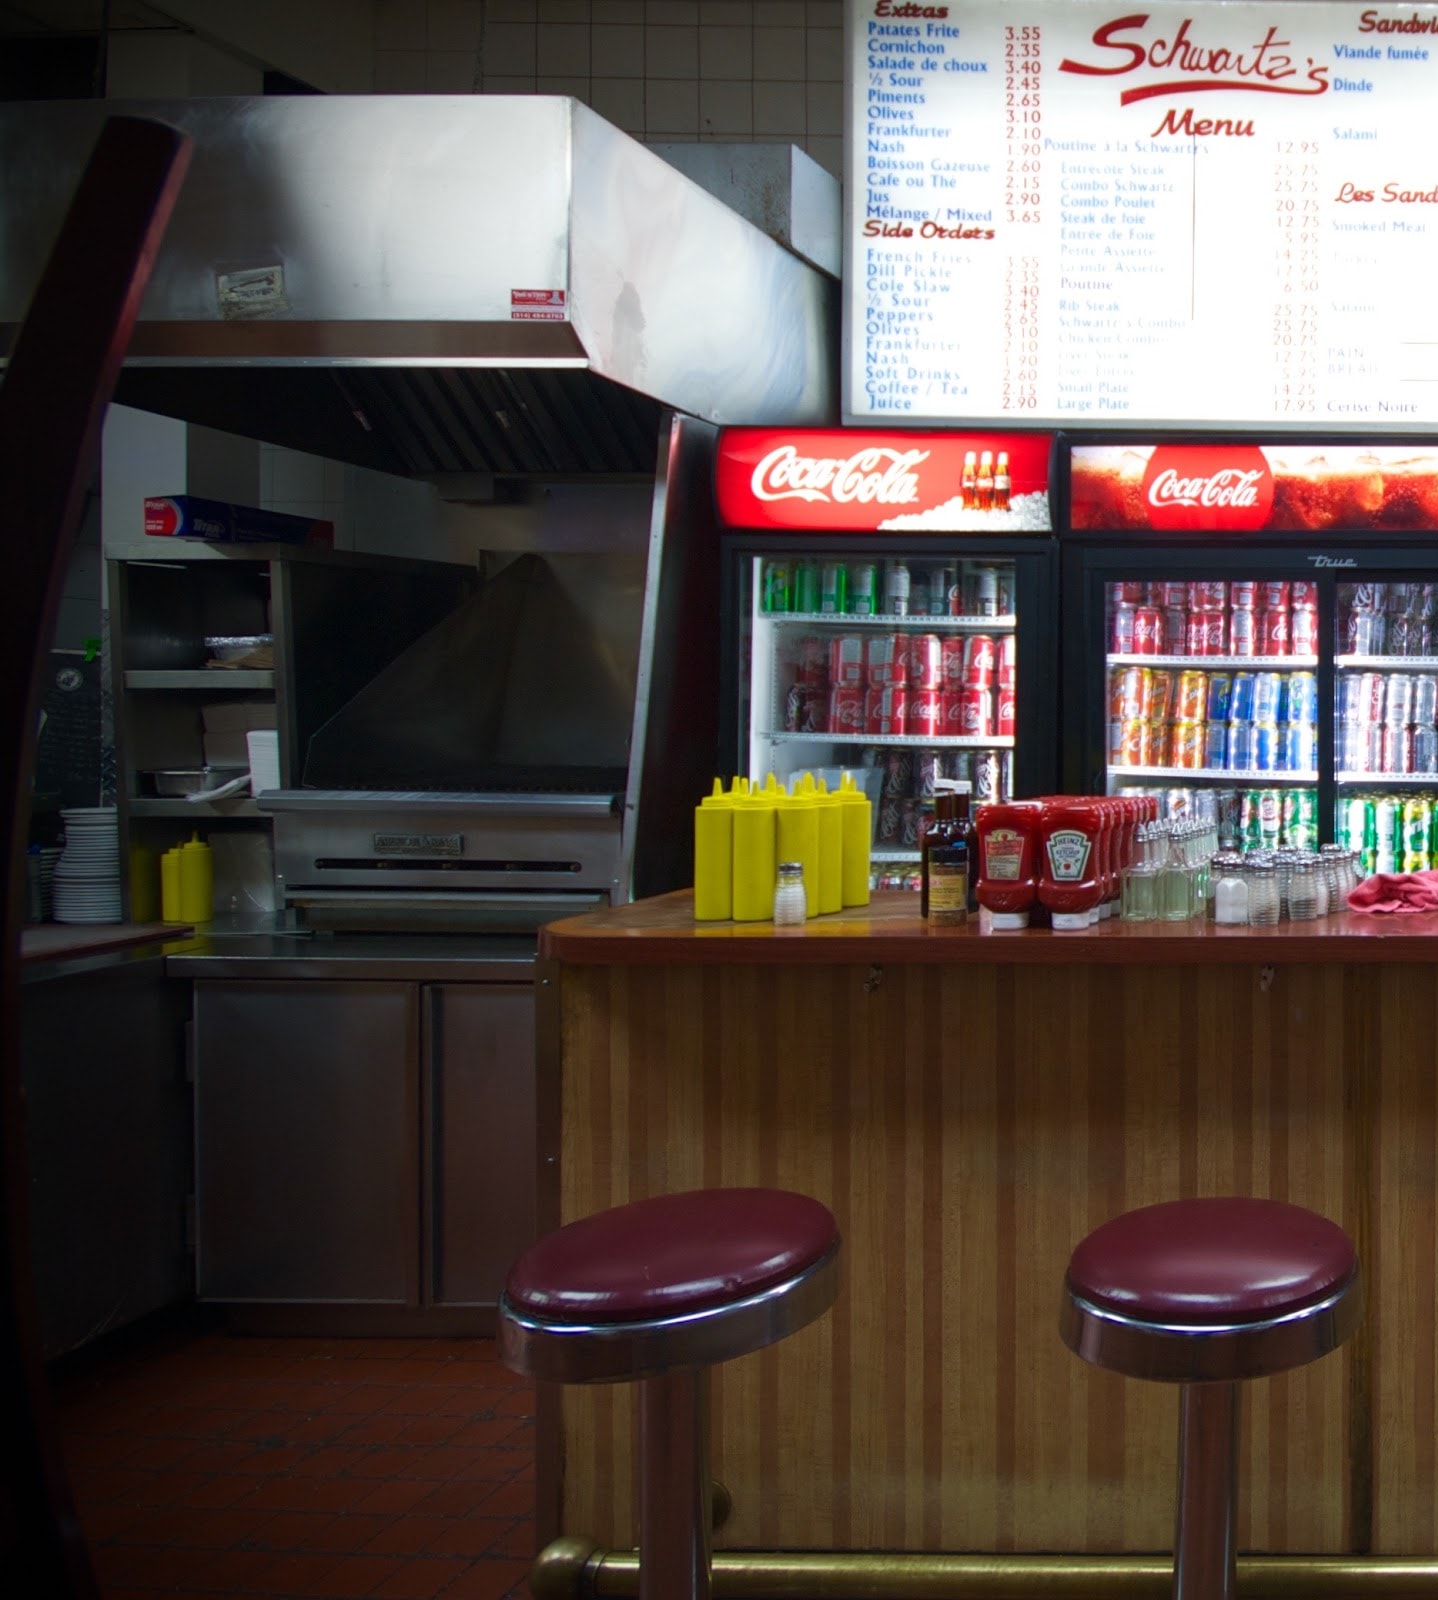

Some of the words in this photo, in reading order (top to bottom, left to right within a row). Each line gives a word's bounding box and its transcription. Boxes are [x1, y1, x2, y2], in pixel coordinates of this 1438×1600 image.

[874, 0, 949, 19] Extras
[867, 22, 921, 37] Patates
[926, 23, 960, 38] Frite
[1004, 26, 1040, 40] 3.55
[867, 39, 944, 54] Cornichon
[1005, 43, 1040, 57] 2.35
[1057, 12, 1329, 97] Schwartz's
[1332, 44, 1381, 59] Viande
[1387, 45, 1429, 60] fumée
[867, 56, 915, 70] Salade
[920, 57, 938, 71] de
[944, 58, 987, 73] choux
[1005, 60, 1040, 74] 3.40
[889, 73, 923, 88] Sour
[1005, 77, 1040, 90] 2.45
[1333, 77, 1373, 91] Dinde
[867, 89, 925, 104] Piments
[1005, 94, 1040, 107] 2.65
[867, 106, 914, 120] Olives
[1005, 110, 1040, 123] 3.10
[1150, 107, 1256, 137] Menu
[867, 123, 951, 138] Frankfurter
[1005, 127, 1040, 140] 2.10
[1333, 127, 1377, 140] Salami
[867, 140, 905, 153] Nash
[1007, 143, 1040, 156] 1.90
[1043, 138, 1096, 152] Poutine
[1117, 140, 1127, 152] la
[1277, 141, 1319, 154] 12.95
[867, 156, 924, 171] Boisson
[929, 158, 990, 173] Gazeuse
[1006, 160, 1040, 173] 2.60
[905, 176, 924, 187] ou
[1006, 177, 1039, 189] 2.15
[1060, 177, 1108, 191] Combo
[1274, 180, 1318, 192] 25.75
[867, 189, 890, 204] Jus
[1005, 193, 1040, 205] 2.90
[1333, 182, 1375, 204] Les
[1060, 194, 1108, 207] Combo
[1114, 195, 1155, 208] Poulet
[1275, 199, 1319, 211] 20.75
[866, 205, 929, 221] Mélange
[947, 206, 991, 221] Mixed
[1006, 209, 1040, 222] 3.65
[1060, 210, 1095, 224] Steak
[1101, 212, 1116, 224] de
[1121, 211, 1146, 225] foie
[1277, 215, 1319, 227] 12.75
[862, 220, 915, 241] Side
[919, 220, 997, 241] Orders
[1332, 216, 1385, 232] Smoked
[866, 247, 922, 263] French
[1005, 255, 1038, 268] 3.55
[866, 264, 895, 277] Dill
[903, 265, 952, 279] Pickle
[1005, 270, 1038, 283] 2.35
[866, 278, 904, 292] Cole
[913, 279, 950, 293] Slaw
[1005, 285, 1039, 298] 3.40
[1061, 277, 1112, 290] Poutine
[1284, 280, 1318, 292] 6.50
[890, 293, 930, 308] Sour
[1004, 299, 1038, 311] 2.45
[1059, 298, 1079, 311] Rib
[1274, 303, 1317, 316] 25.75
[866, 307, 934, 324] Peppers
[1004, 312, 1038, 325] 2.65
[866, 322, 920, 336] Olives
[1004, 326, 1038, 339] 3.10
[866, 336, 961, 352] Frankfurter
[1004, 340, 1038, 353] 2.10
[866, 351, 908, 366] Nash
[1005, 355, 1038, 368] 1.90
[866, 366, 898, 381] Soft
[906, 367, 960, 381] Drinks
[1003, 369, 1037, 382] 2.60
[866, 380, 918, 395] Coffee
[942, 381, 968, 396] Tea
[1002, 383, 1037, 396] 2.15
[868, 395, 911, 410] Juice
[1002, 397, 1037, 410] 2.90
[1057, 397, 1092, 411] Large
[1098, 397, 1129, 409] Plate
[1273, 399, 1315, 411] 17.95
[751, 445, 931, 504] Coca-Cola
[1149, 468, 1265, 508] Coca-Cola
